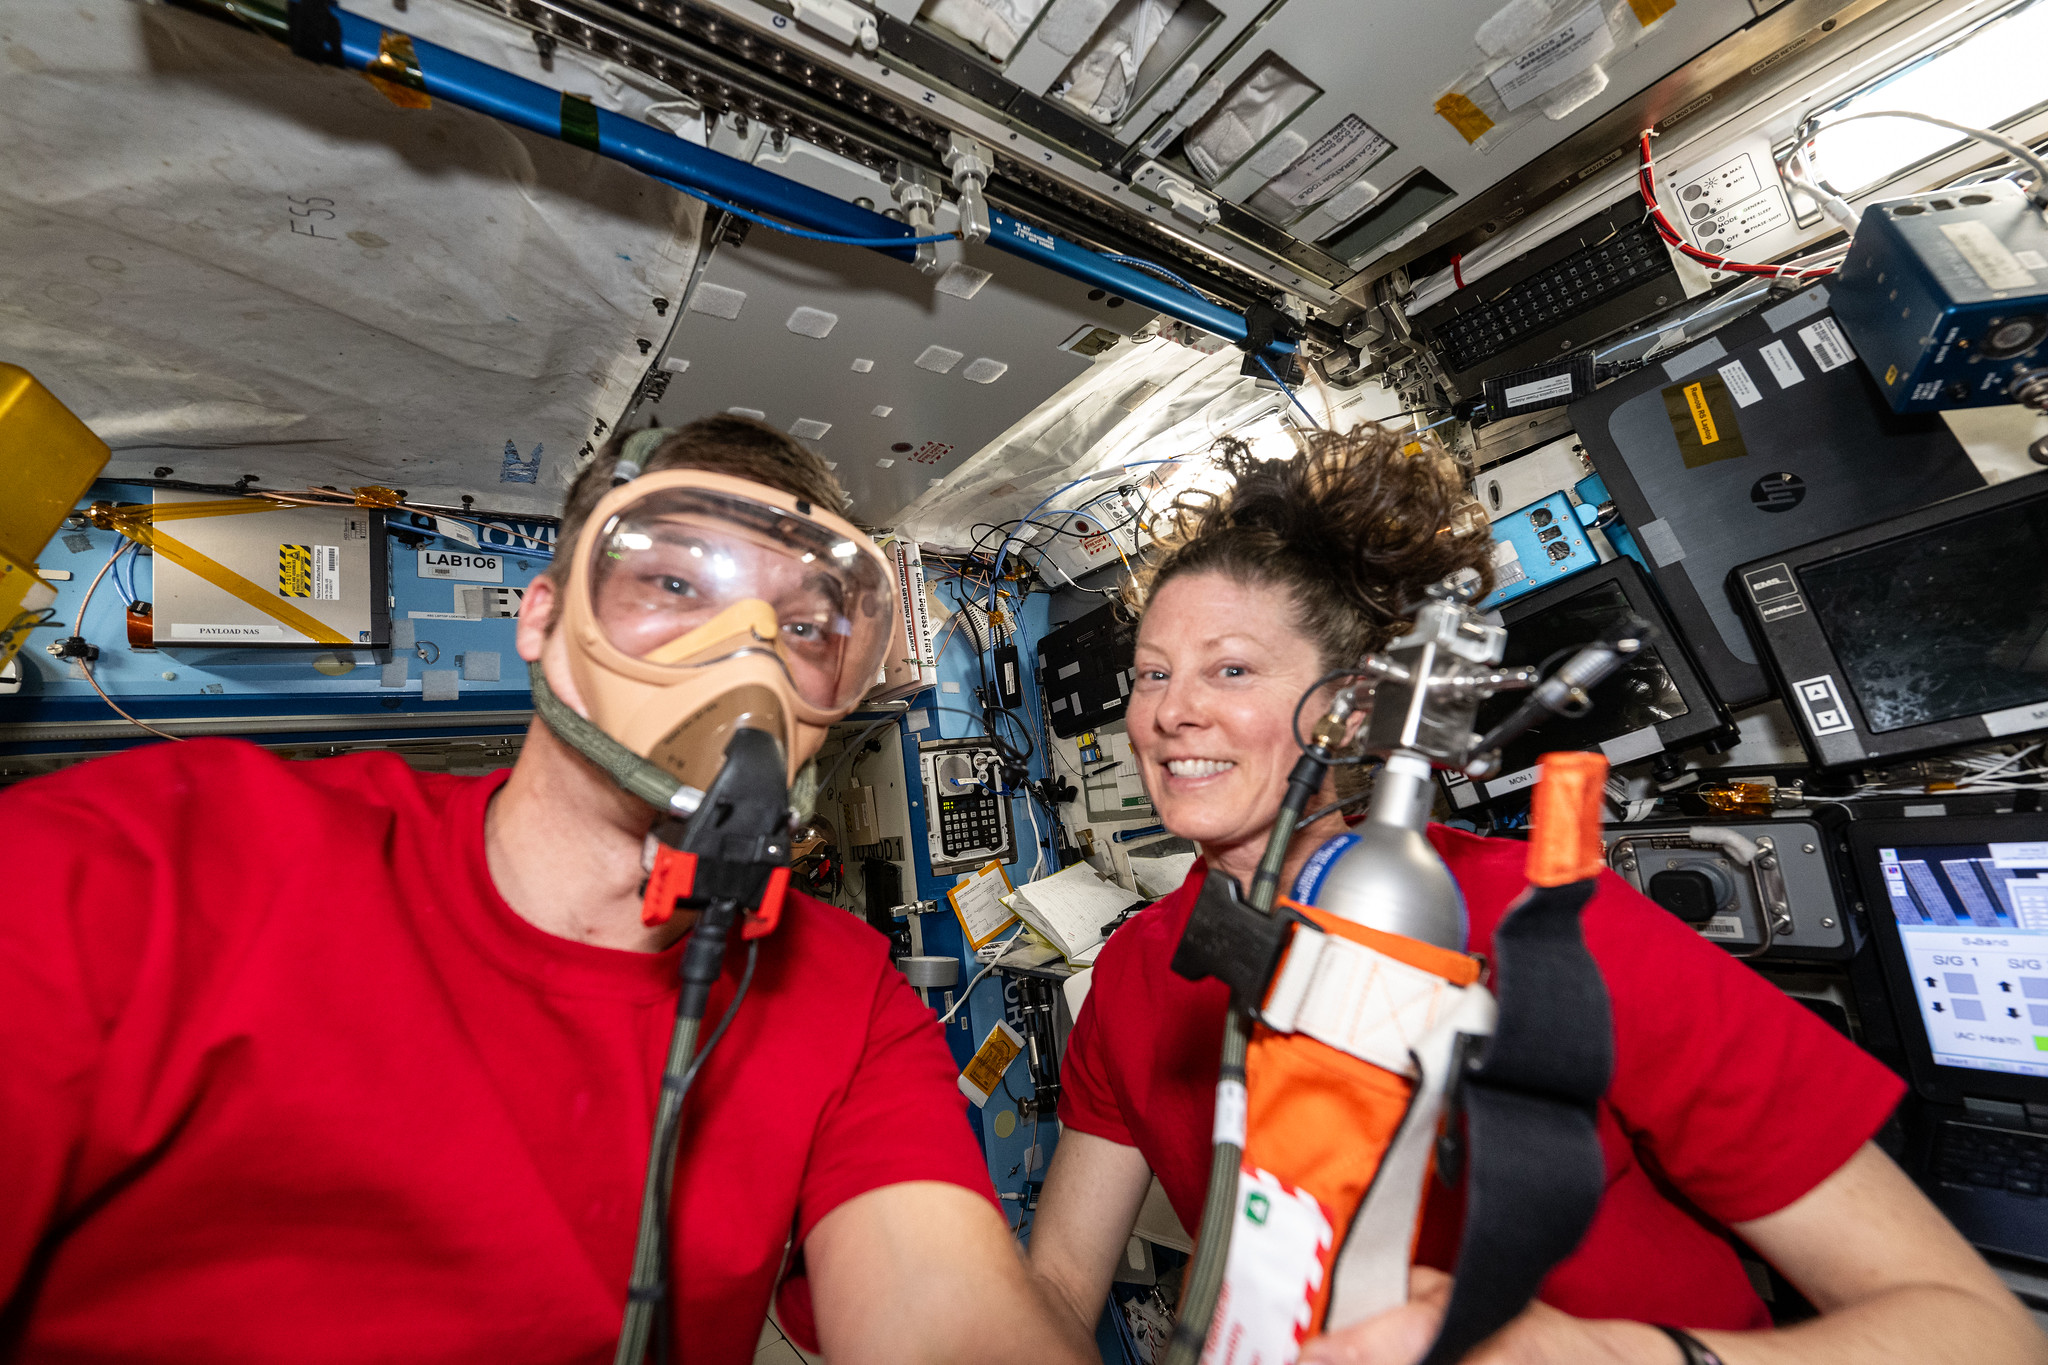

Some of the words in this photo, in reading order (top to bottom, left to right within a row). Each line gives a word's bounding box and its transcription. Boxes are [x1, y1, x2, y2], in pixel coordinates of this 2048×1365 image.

[1718, 216, 1739, 228] MODE
[1690, 386, 1702, 410] Remote
[1699, 409, 1706, 419] RS
[1701, 417, 1713, 440] Laptop
[199, 628, 242, 636] PAYLOAD
[243, 628, 260, 636] NAS
[1508, 775, 1527, 786] MON
[895, 837, 902, 861] 1
[1932, 955, 1964, 966] S/G
[2007, 958, 2042, 970] S/G
